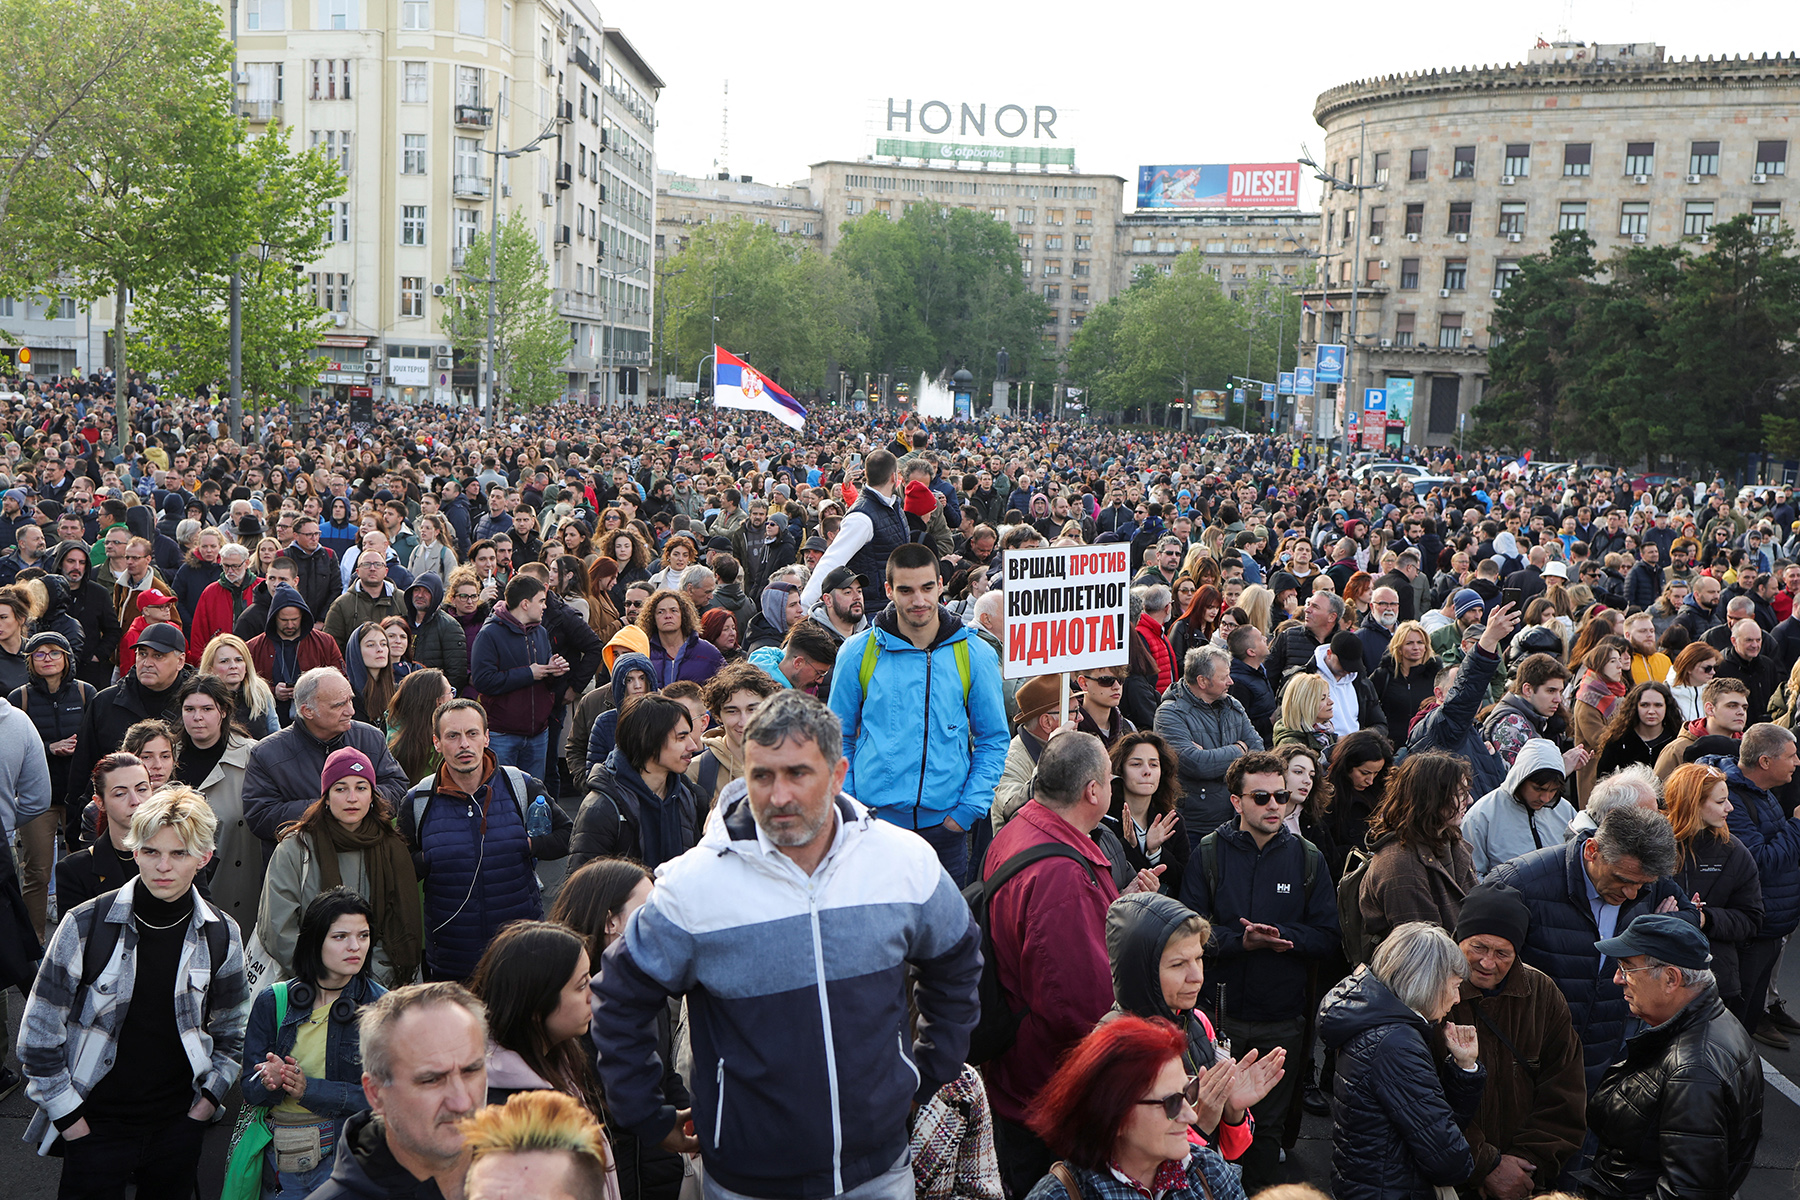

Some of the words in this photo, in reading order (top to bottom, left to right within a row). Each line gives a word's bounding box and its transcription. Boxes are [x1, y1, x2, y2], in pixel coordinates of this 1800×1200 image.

[887, 97, 1058, 139] HONOR
[1232, 170, 1295, 197] DIESEL
[1369, 390, 1383, 408] P
[1009, 556, 1066, 580] ВРШАЦ
[1070, 551, 1126, 576] ПРОТИВ
[1008, 582, 1126, 617] КОМПЛЕТНОГ
[1009, 613, 1124, 666] ИДИОТА!
[1277, 883, 1290, 891] HH
[247, 970, 257, 985] RD
[251, 961, 266, 975] AN
